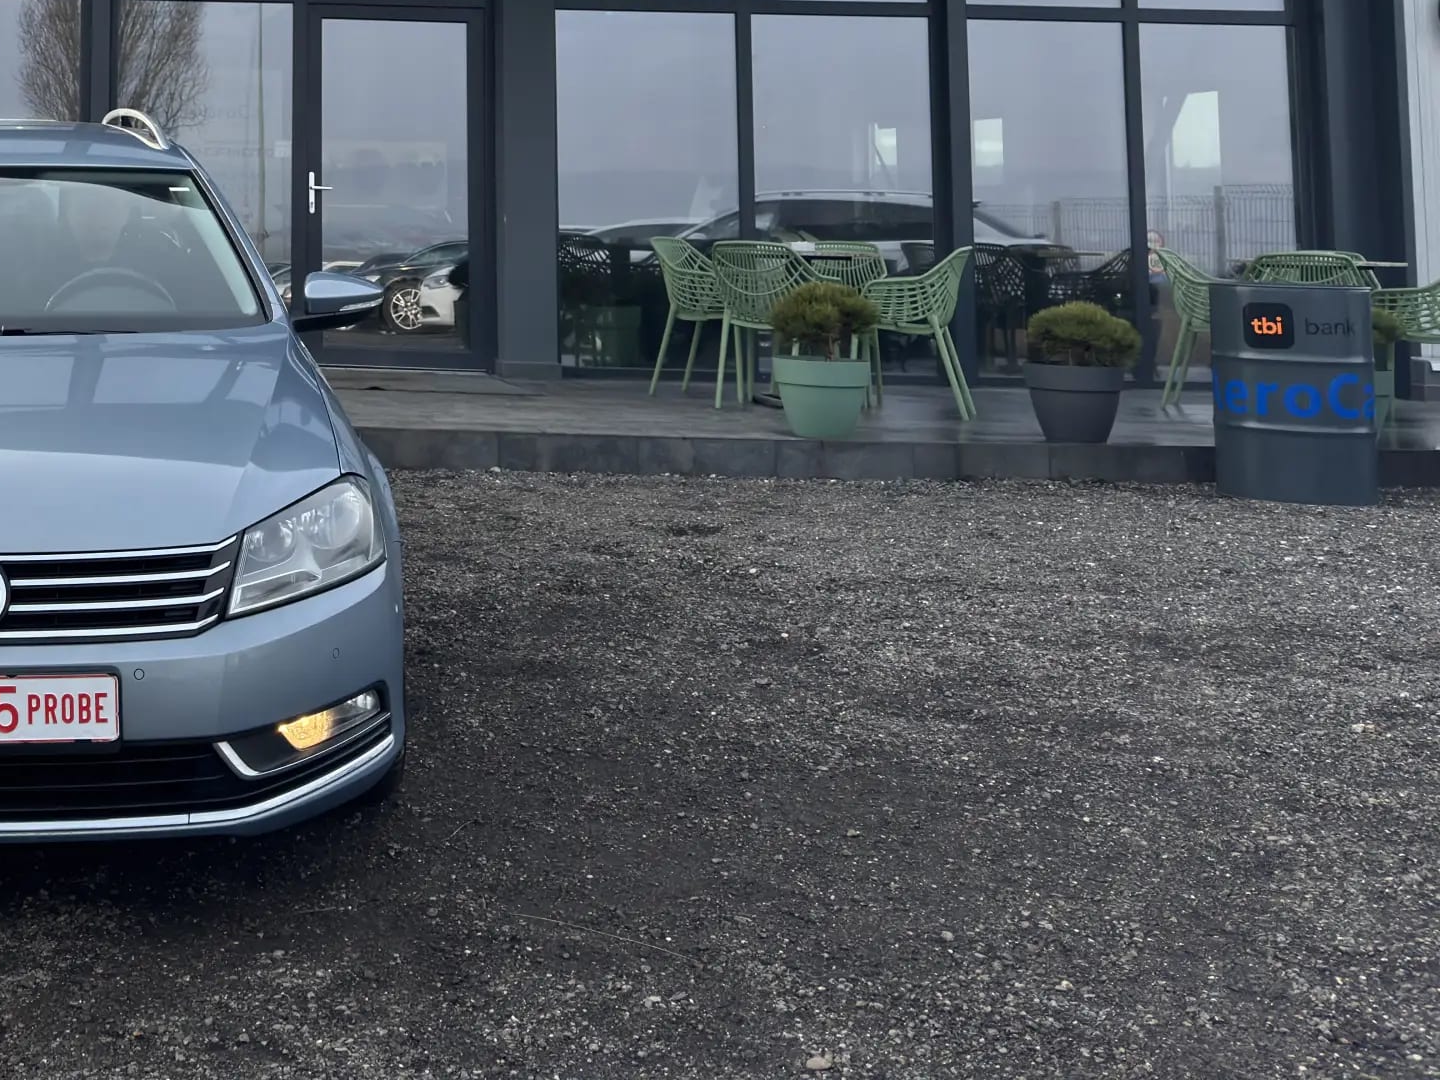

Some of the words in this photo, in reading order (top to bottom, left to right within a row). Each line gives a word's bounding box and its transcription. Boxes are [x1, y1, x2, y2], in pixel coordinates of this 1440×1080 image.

[1250, 316, 1283, 336] tbi
[1304, 318, 1356, 338] bank
[26, 692, 109, 726] PROBE
